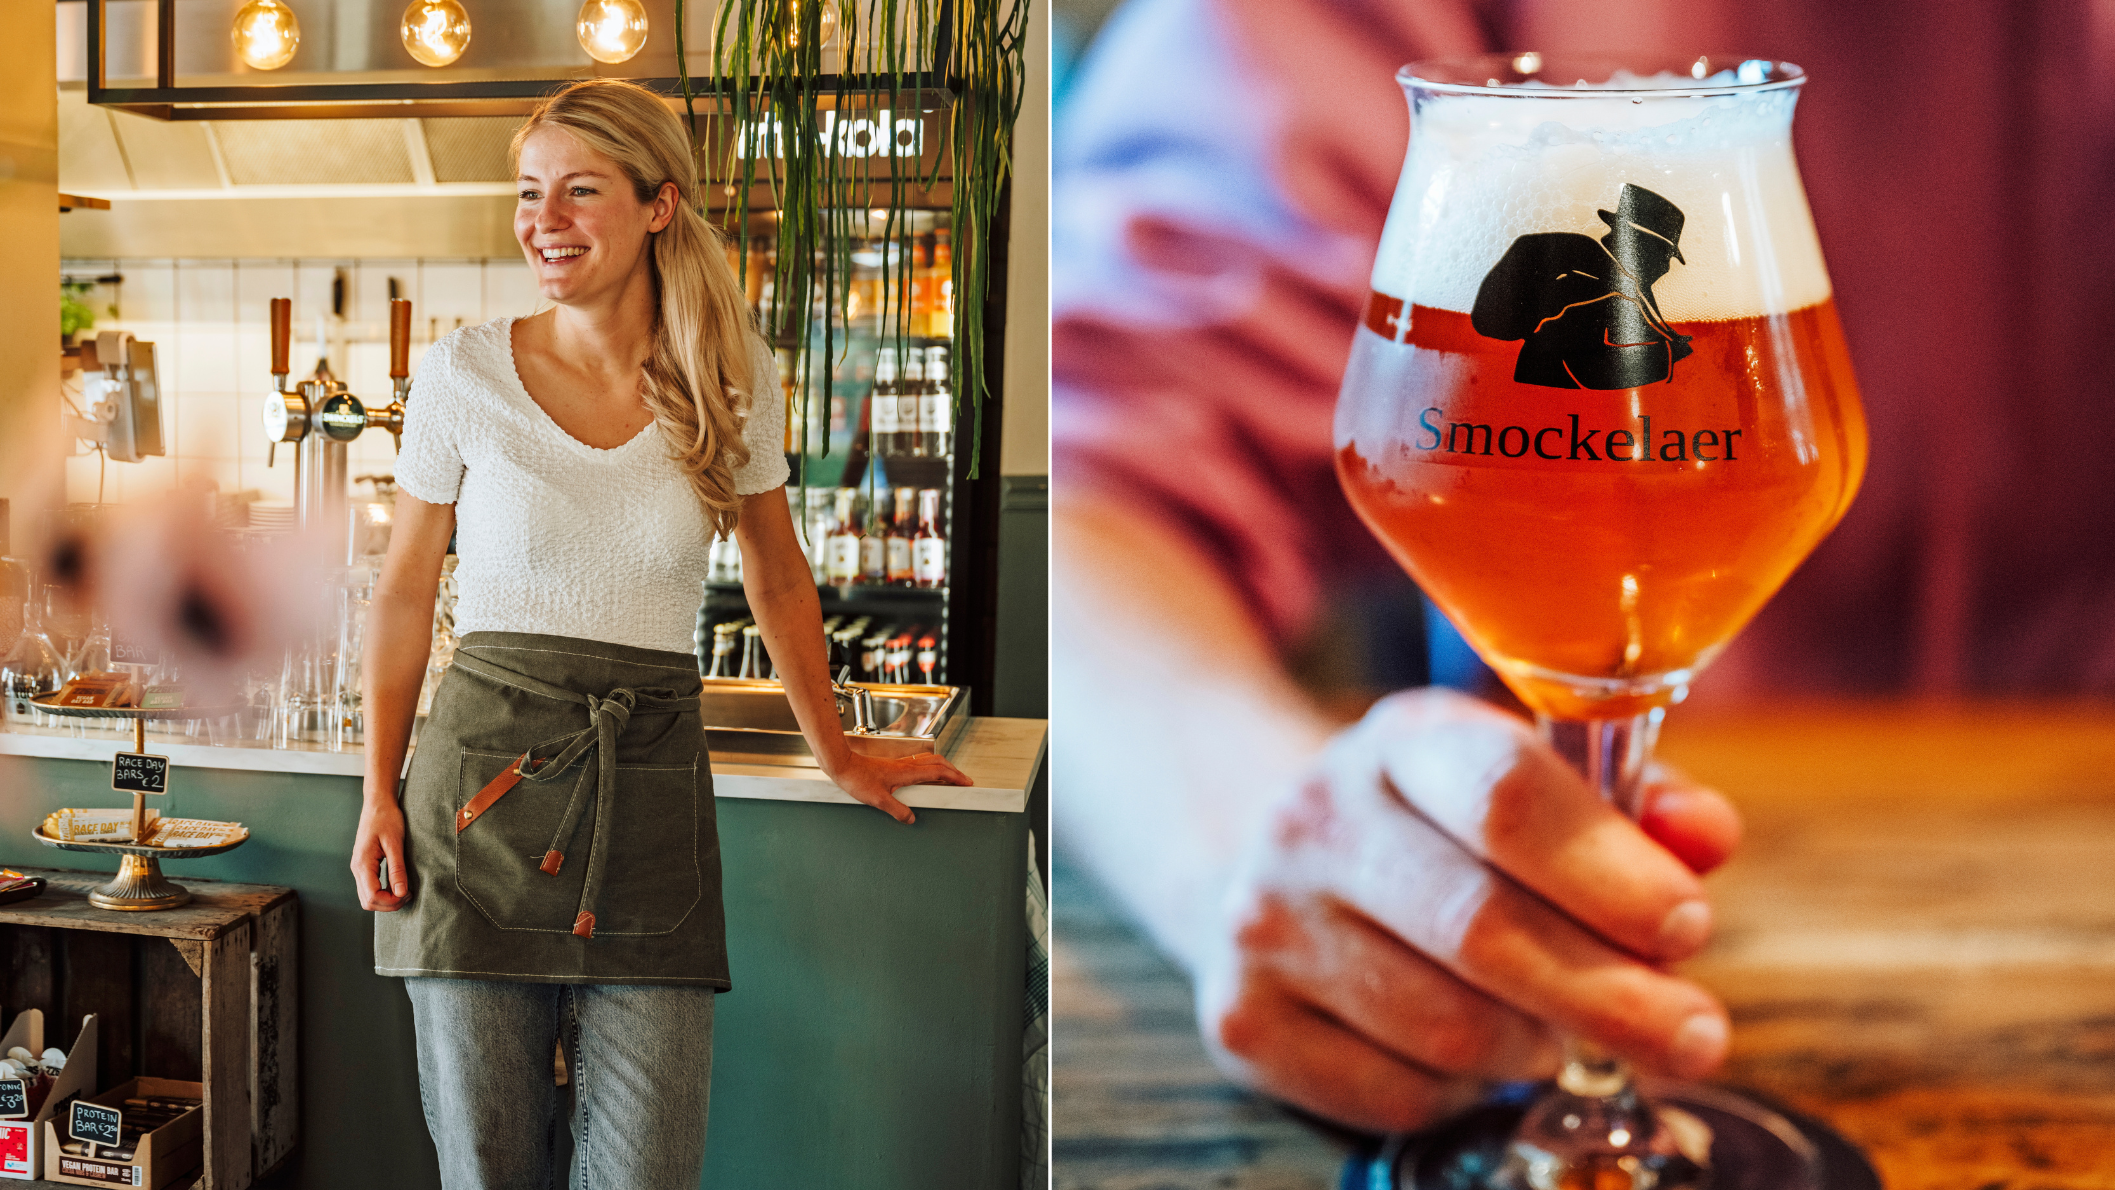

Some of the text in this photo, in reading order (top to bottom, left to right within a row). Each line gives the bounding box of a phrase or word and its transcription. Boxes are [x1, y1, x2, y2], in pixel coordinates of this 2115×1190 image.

[733, 110, 925, 160] -kola
[1415, 407, 1742, 462] Smockelaer
[115, 644, 146, 660] BAR
[118, 756, 165, 773] RACE DAY
[116, 768, 145, 780] BARS
[74, 823, 98, 834] RACE
[100, 821, 119, 833] DAY
[76, 1107, 118, 1123] PROTEIN
[75, 1120, 98, 1135] BAR
[62, 1159, 81, 1171] VEGAN
[82, 1162, 106, 1174] PROTEIN
[106, 1166, 119, 1176] BAR
